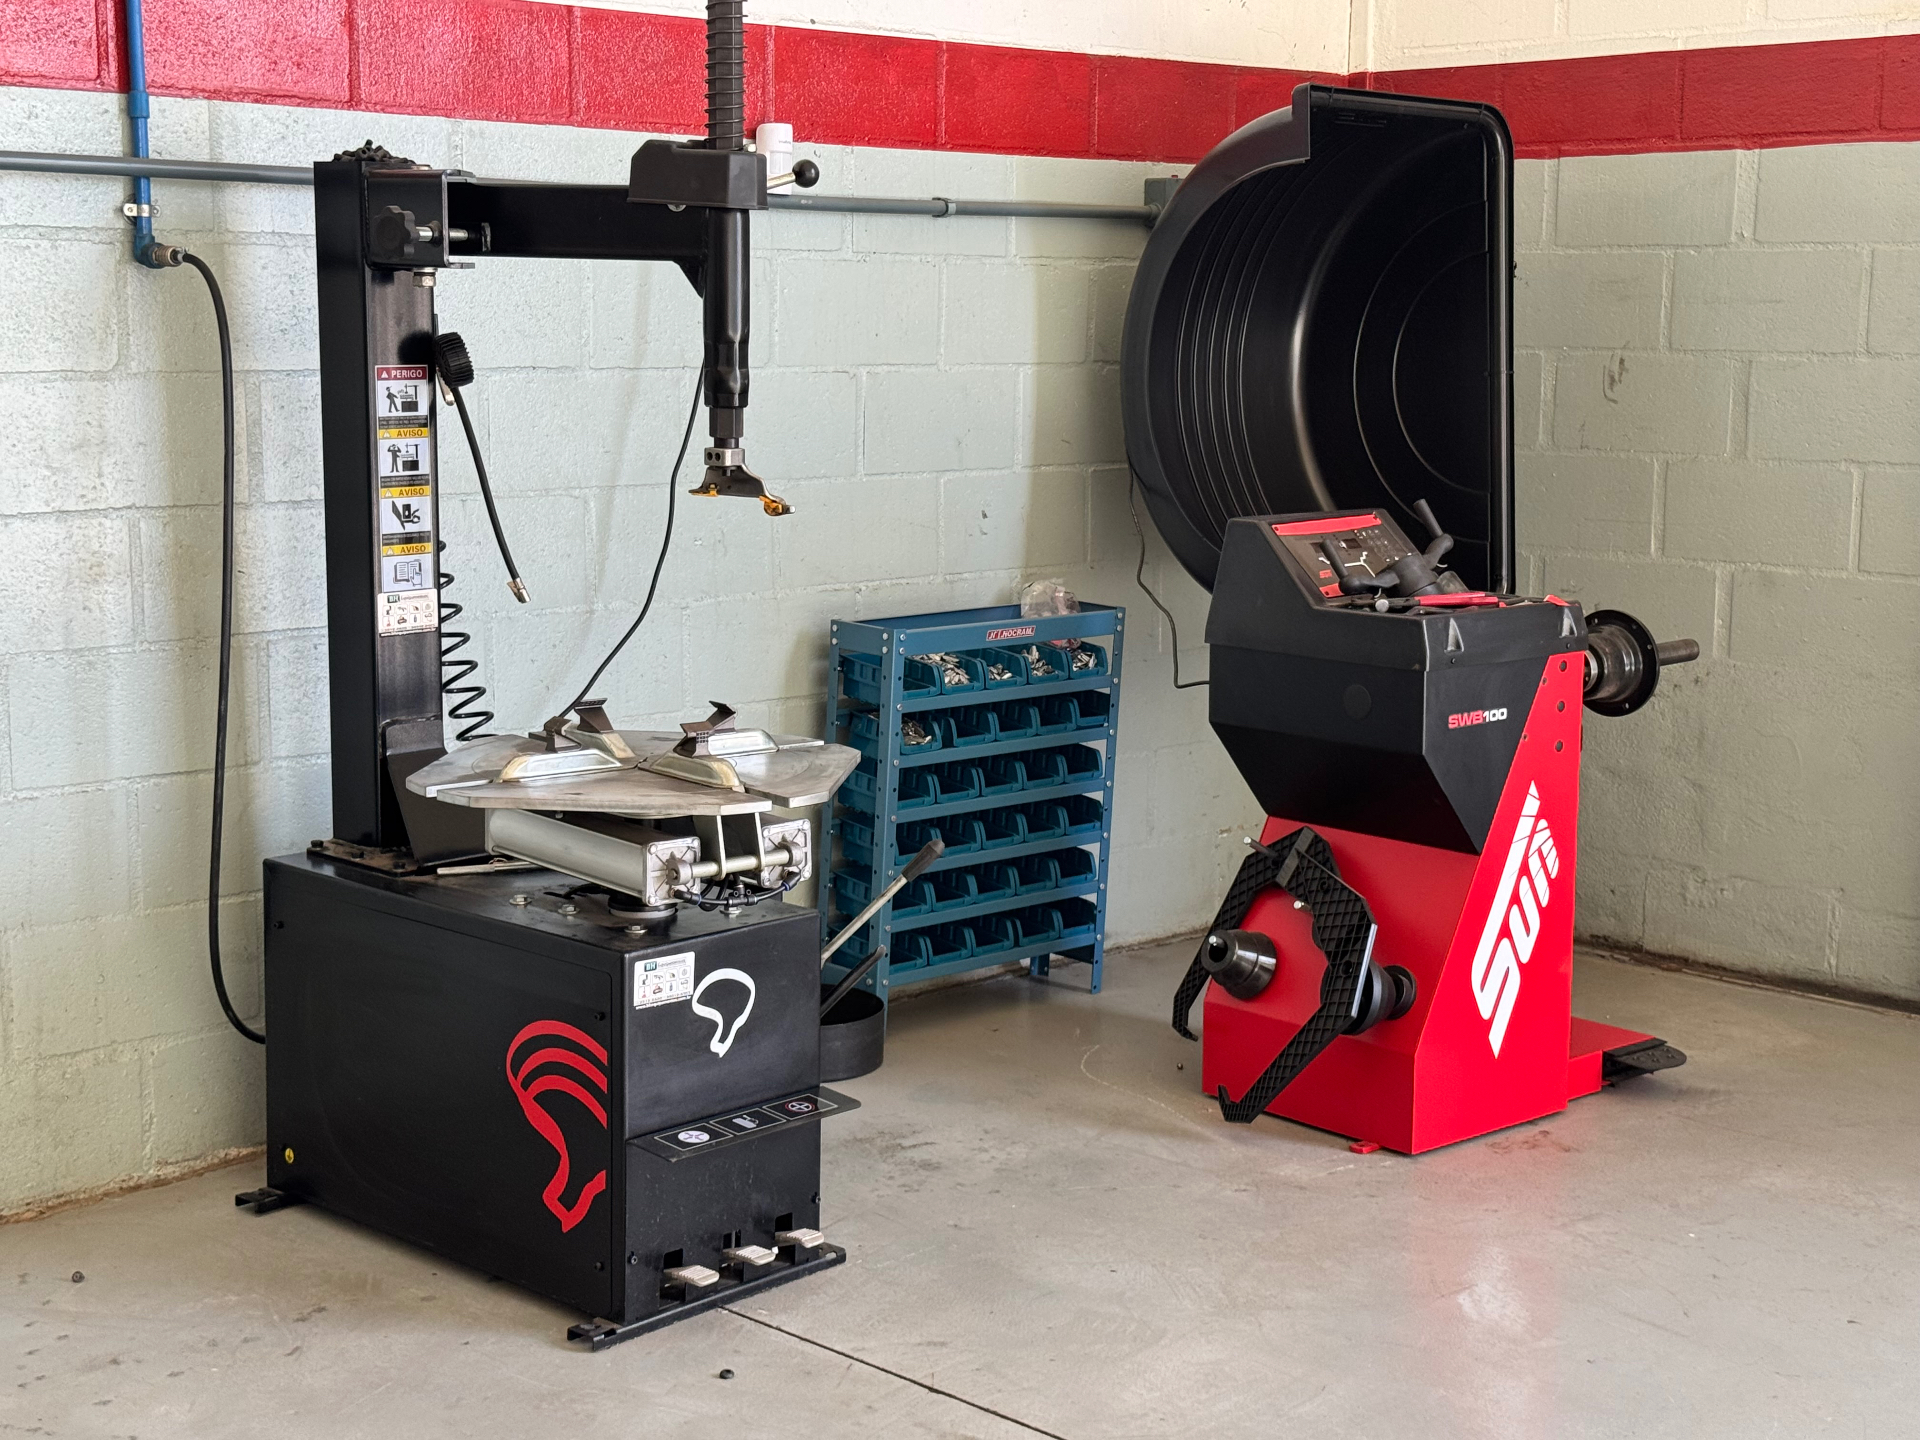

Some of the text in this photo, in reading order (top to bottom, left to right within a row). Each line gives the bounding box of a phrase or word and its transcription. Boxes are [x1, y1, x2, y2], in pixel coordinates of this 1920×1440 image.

[391, 369, 423, 378] PERIGO
[396, 428, 423, 438] AVISO
[398, 487, 425, 497] AVISO
[400, 544, 426, 554] AVISO
[1448, 707, 1508, 729] SWB100
